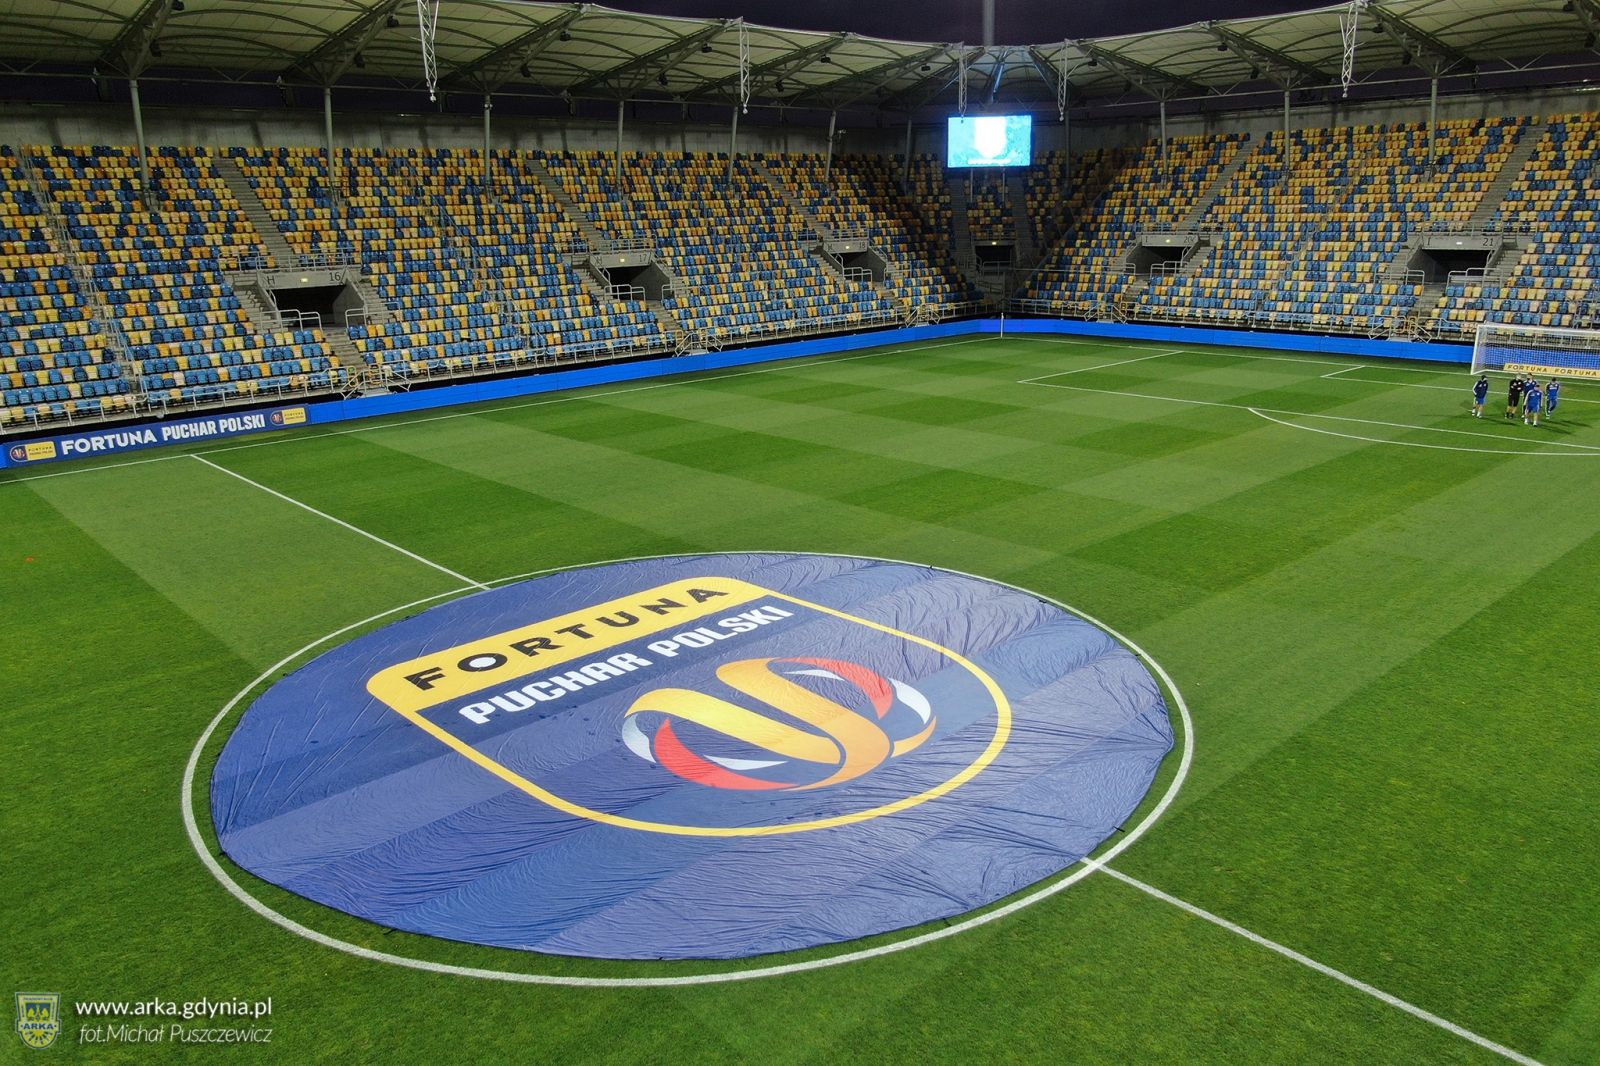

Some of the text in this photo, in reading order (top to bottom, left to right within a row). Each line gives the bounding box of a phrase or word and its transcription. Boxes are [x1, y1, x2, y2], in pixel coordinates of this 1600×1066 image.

[859, 241, 866, 249] 18
[1482, 237, 1494, 246] 21
[638, 253, 648, 263] 17
[266, 275, 276, 285] H
[329, 271, 341, 282] 16
[1507, 364, 1597, 377] FORTUNA FORTUNA
[61, 413, 266, 455] FORTUNA PUCHAR POLSKI
[403, 587, 729, 691] FORTUNA
[458, 605, 795, 724] PUCHAR POLSKI
